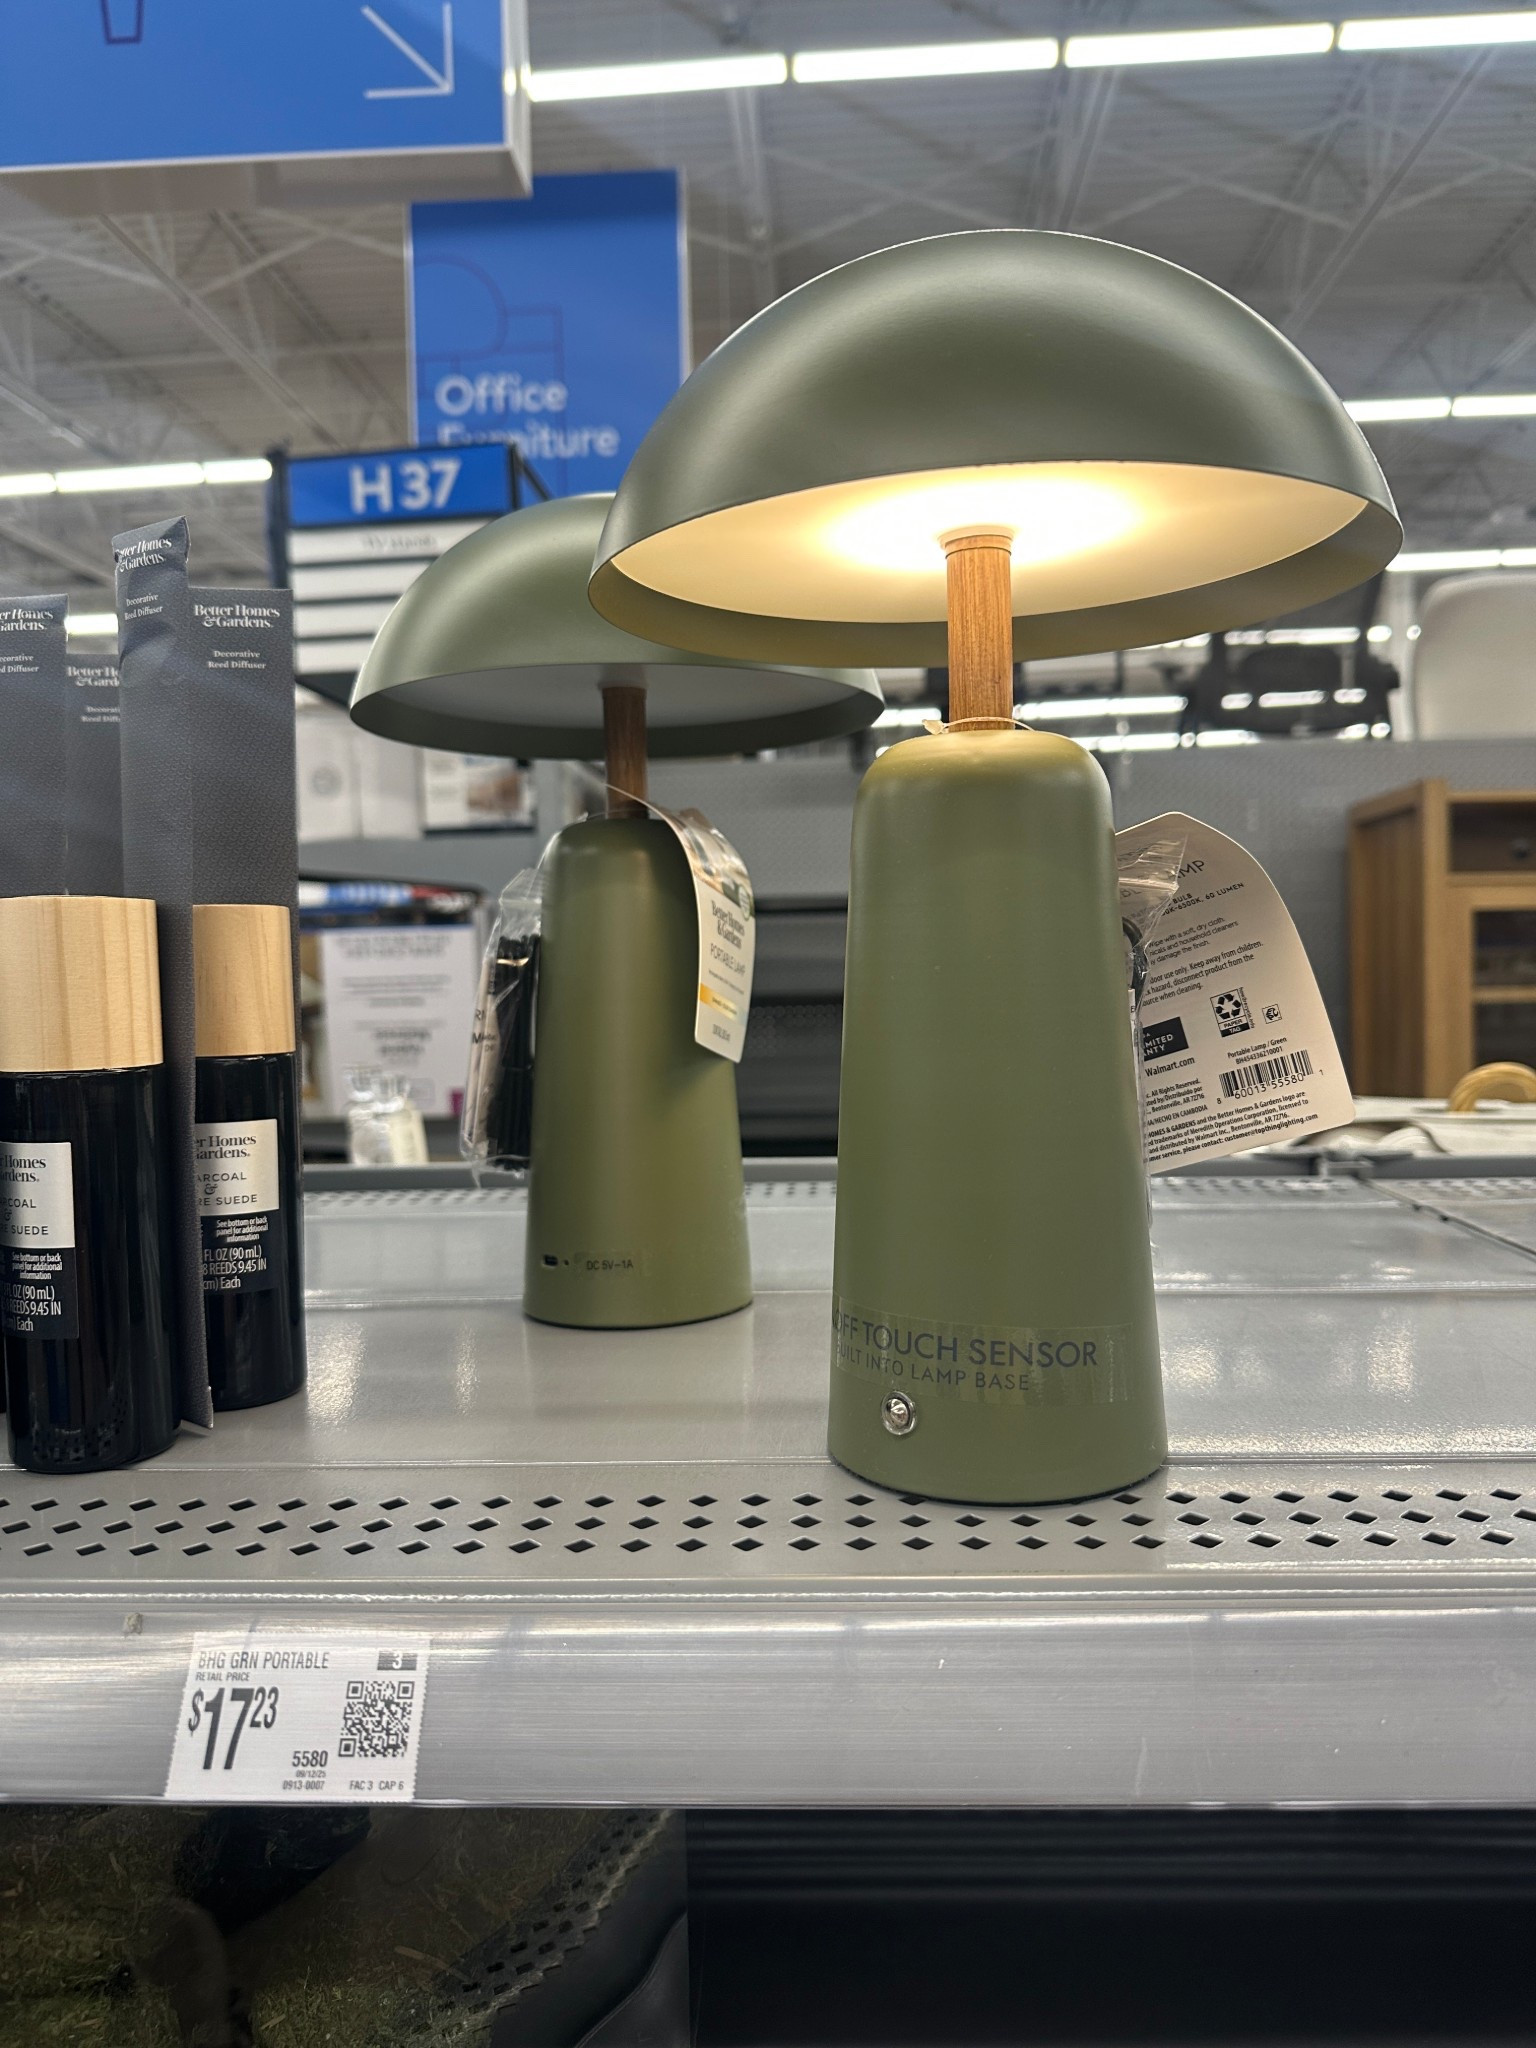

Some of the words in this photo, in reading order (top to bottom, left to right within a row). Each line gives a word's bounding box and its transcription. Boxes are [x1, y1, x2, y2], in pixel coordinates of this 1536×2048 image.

[434, 372, 568, 417] Office
[350, 464, 393, 514] H
[401, 456, 461, 510] 37
[137, 538, 173, 554] Homes
[126, 593, 159, 606] Decorative
[12, 609, 54, 620] Homes
[124, 609, 137, 620] Reed
[137, 606, 163, 618] Diffuser
[194, 604, 233, 616] Better
[235, 604, 280, 617] Homes
[213, 650, 260, 658] Decorative
[8, 665, 39, 673] Diffuser
[208, 660, 229, 669] Reed
[231, 660, 266, 669] Diffuser
[1216, 882, 1243, 895] LUMEN
[1172, 893, 1192, 903] BULB
[1163, 933, 1176, 942] with
[1196, 922, 1206, 932] dry
[1166, 941, 1178, 949] and
[1178, 930, 1211, 945] household
[1211, 920, 1238, 933] cleaners
[1156, 950, 1181, 962] damage
[1181, 945, 1192, 953] the
[1163, 970, 1174, 978] use
[1189, 959, 1204, 969] Keep
[1205, 955, 1220, 964] away
[1221, 948, 1235, 958] from
[1236, 939, 1263, 953] children.
[1151, 982, 1172, 993] hazard,
[1172, 971, 1204, 986] disconnect
[1204, 962, 1227, 976] product
[1227, 957, 1242, 966] from
[1242, 953, 1254, 961] the
[1158, 989, 1175, 1000] when
[1175, 980, 1203, 995] cleaning.
[1223, 1018, 1242, 1027] PAPER
[1227, 1047, 1250, 1058] Portable
[1250, 1042, 1266, 1051] Lamp
[1270, 1036, 1286, 1045] Green
[1144, 1056, 1195, 1076] Walmart.com
[1158, 1085, 1174, 1095] Rights
[1216, 1097, 1222, 1105] 8
[1233, 1083, 1266, 1098] 60013
[1270, 1072, 1304, 1088] 55580
[1151, 1099, 1182, 1112] Bentonville,
[1190, 1092, 1204, 1101] 72716
[1170, 1119, 1195, 1131] GARDENS
[1196, 1116, 1206, 1124] and
[1217, 1109, 1233, 1118] Better
[1234, 1104, 1253, 1114] Homes
[1259, 1096, 1281, 1107] Gardens
[1282, 1093, 1294, 1102] logo
[1172, 1111, 1180, 1119] EN
[1180, 1104, 1207, 1116] CAMBODIA
[1153, 1131, 1183, 1144] trademarks
[1190, 1123, 1213, 1134] Meredith
[1214, 1115, 1243, 1128] Operations
[1243, 1106, 1278, 1120] Corporation,
[1278, 1099, 1301, 1111] licensed
[209, 1135, 257, 1148] Homes
[1158, 1138, 1187, 1151] distributed
[1195, 1130, 1218, 1141] Walmart
[1230, 1118, 1263, 1132] Bentonville,
[1161, 1148, 1181, 1159] service,
[1182, 1143, 1200, 1153] please
[1201, 1137, 1223, 1148] contact:
[1223, 1112, 1317, 1143] customer@topthinglighting.com
[5, 1154, 47, 1169] Homes
[205, 1183, 218, 1195] &
[216, 1194, 258, 1205] SUEDE
[217, 1220, 228, 1228] See
[228, 1218, 249, 1227] bottom
[255, 1215, 268, 1224] back
[11, 1225, 49, 1236] SUEDE
[216, 1227, 233, 1238] panel
[233, 1226, 241, 1234] for
[242, 1223, 269, 1233] additional
[226, 1233, 260, 1243] information
[20, 1253, 40, 1262] bottom
[46, 1252, 62, 1262] back
[204, 1248, 214, 1261] FL
[216, 1247, 228, 1261] OZ
[229, 1246, 245, 1262] (90
[245, 1244, 262, 1259] mL)
[24, 1262, 33, 1271] for
[32, 1262, 63, 1271] additional
[209, 1261, 238, 1275] REEDS
[238, 1259, 257, 1273] 9.45
[258, 1257, 267, 1271] IN
[586, 1260, 600, 1271] DC
[20, 1271, 52, 1280] information
[220, 1275, 241, 1289] Each
[12, 1284, 22, 1299] OZ
[22, 1284, 36, 1301] (90
[36, 1285, 55, 1301] mL)
[30, 1301, 50, 1316] 9.45
[50, 1301, 62, 1315] IN
[16, 1316, 34, 1332] Each
[862, 1320, 958, 1362] TOUCH
[968, 1338, 1098, 1368] SENSOR
[838, 1341, 862, 1365] UILT
[866, 1352, 904, 1376] INTO
[911, 1363, 967, 1386] LAMP
[975, 1370, 1030, 1392] BASE
[198, 1651, 226, 1669] BHG
[230, 1651, 258, 1669] GRN
[262, 1651, 330, 1669] PORTABLE
[391, 1651, 403, 1669] 3
[195, 1671, 223, 1681] RETAIL
[225, 1672, 250, 1682] PRICE
[292, 1749, 329, 1768] 5580
[282, 1780, 325, 1791] 0913-0007
[349, 1780, 366, 1791] FAC
[366, 1780, 373, 1791] 3
[378, 1780, 396, 1791] CAP
[397, 1780, 404, 1791] 6
